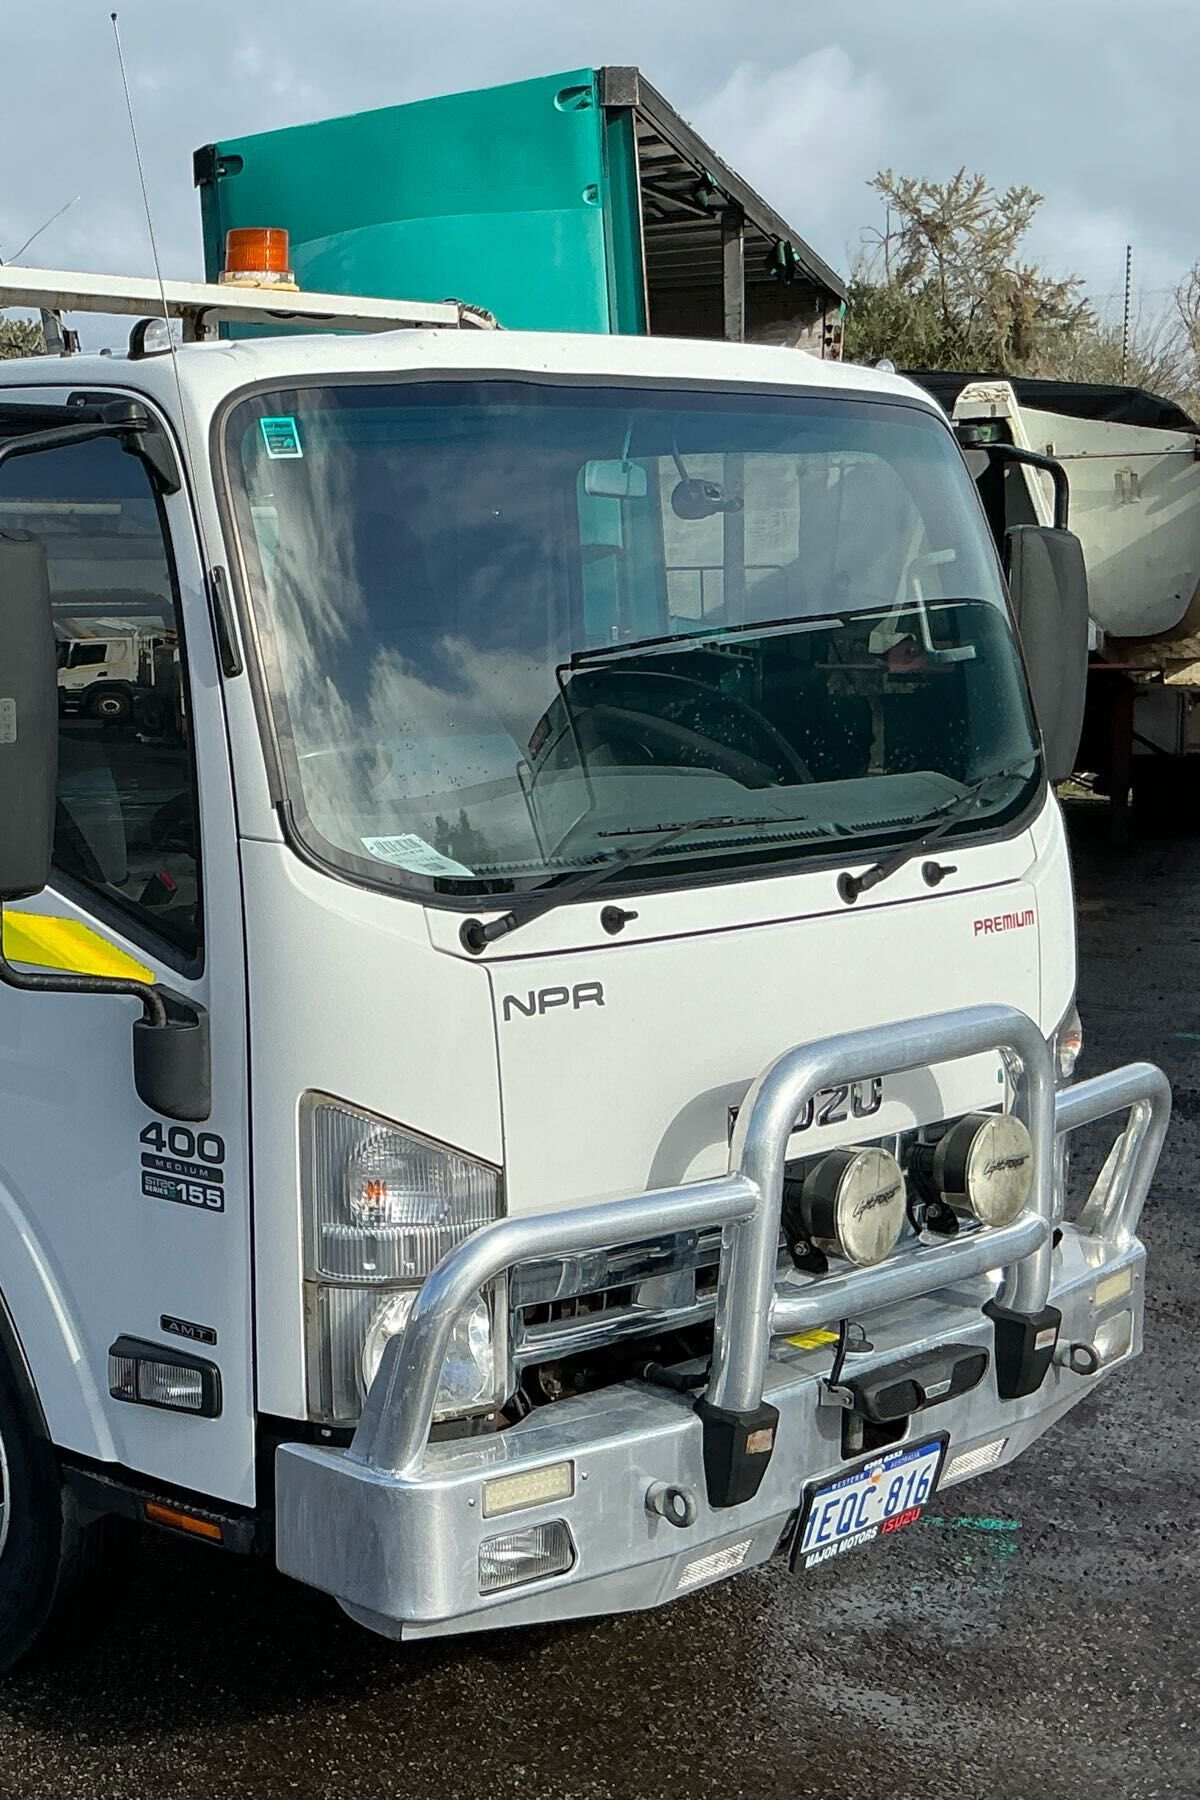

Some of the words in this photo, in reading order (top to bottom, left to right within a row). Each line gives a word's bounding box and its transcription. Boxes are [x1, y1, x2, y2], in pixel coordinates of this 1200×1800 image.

[973, 909, 1035, 937] PREMIUM
[502, 981, 606, 1022] NPR
[139, 1121, 226, 1165] 400
[154, 1158, 209, 1178] MEDIUM
[176, 1183, 222, 1209] 155
[168, 1321, 206, 1339] AMT
[802, 1486, 877, 1549] 1EQC
[883, 1463, 933, 1518] 816
[804, 1542, 839, 1569] MAJOR
[839, 1525, 879, 1553] MOTORS
[880, 1507, 921, 1535] ISUZU
